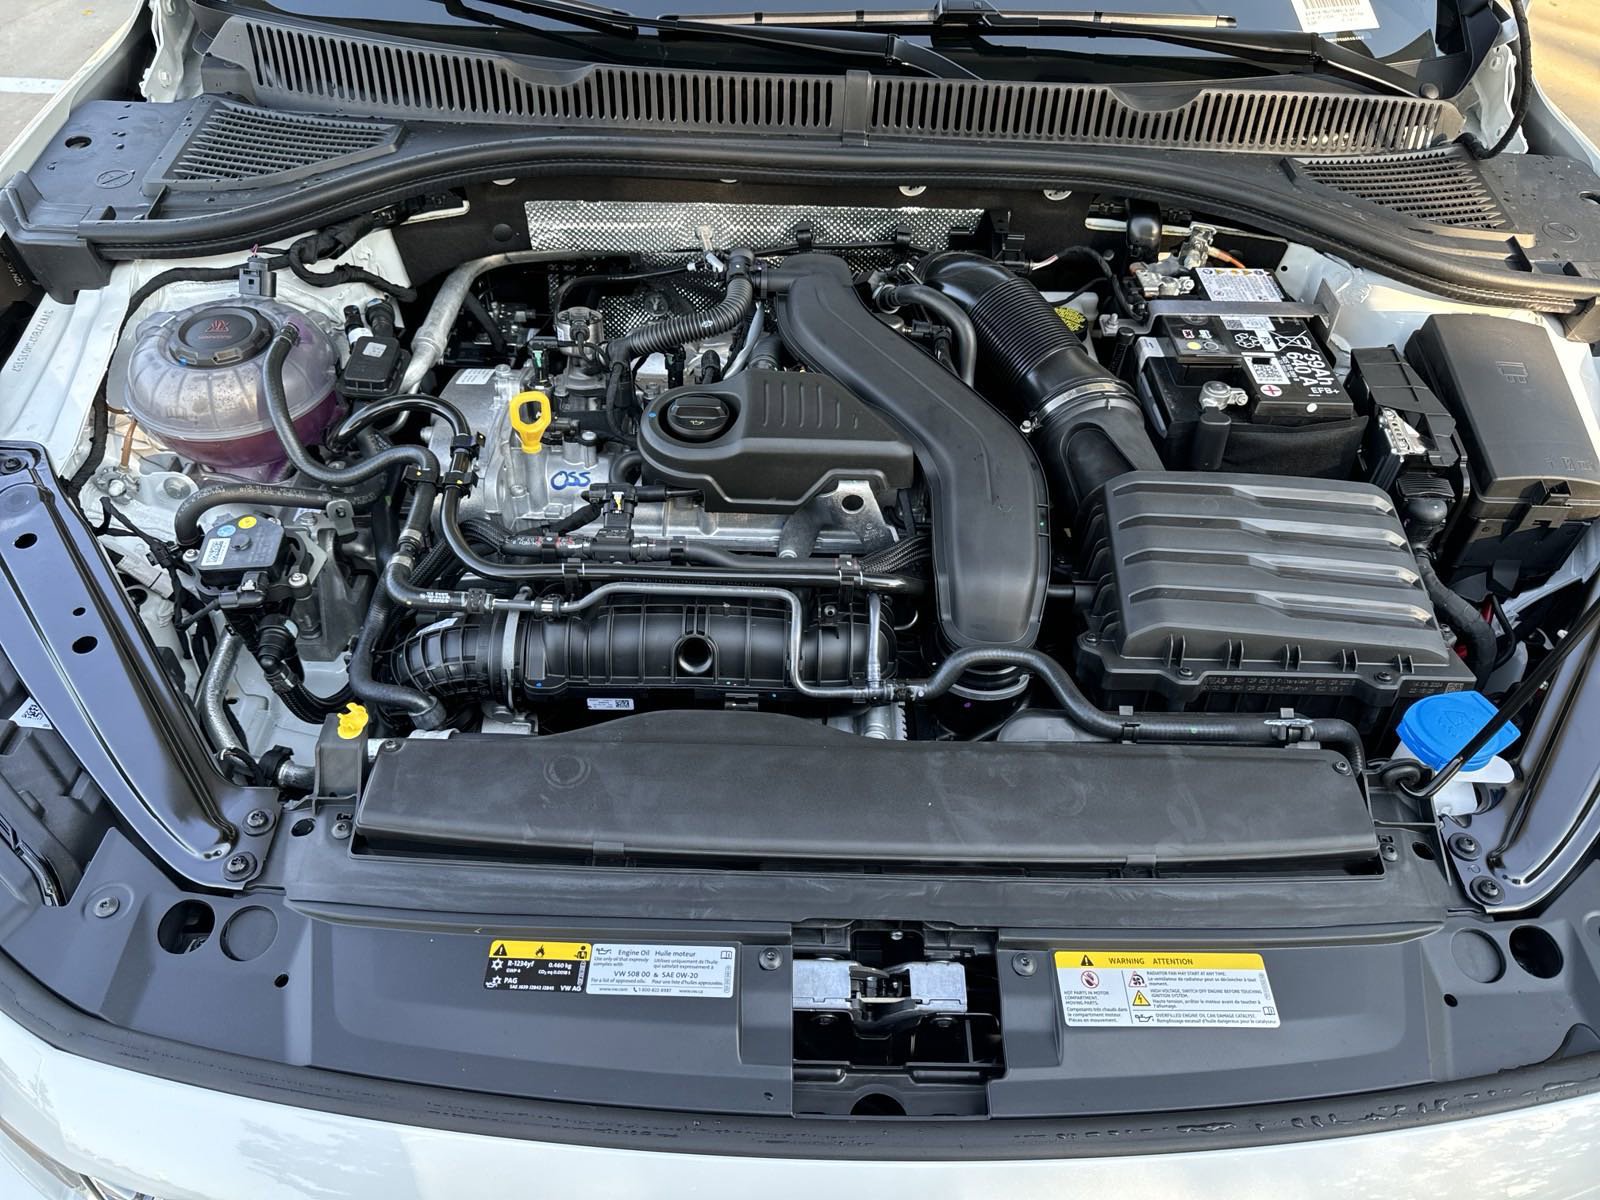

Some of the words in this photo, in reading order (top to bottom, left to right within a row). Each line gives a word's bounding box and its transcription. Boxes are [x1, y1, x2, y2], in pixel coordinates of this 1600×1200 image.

[1286, 352, 1312, 374] 640
[1304, 353, 1334, 385] 59Ah
[1298, 376, 1318, 386] A
[508, 960, 535, 968] R-1234yf
